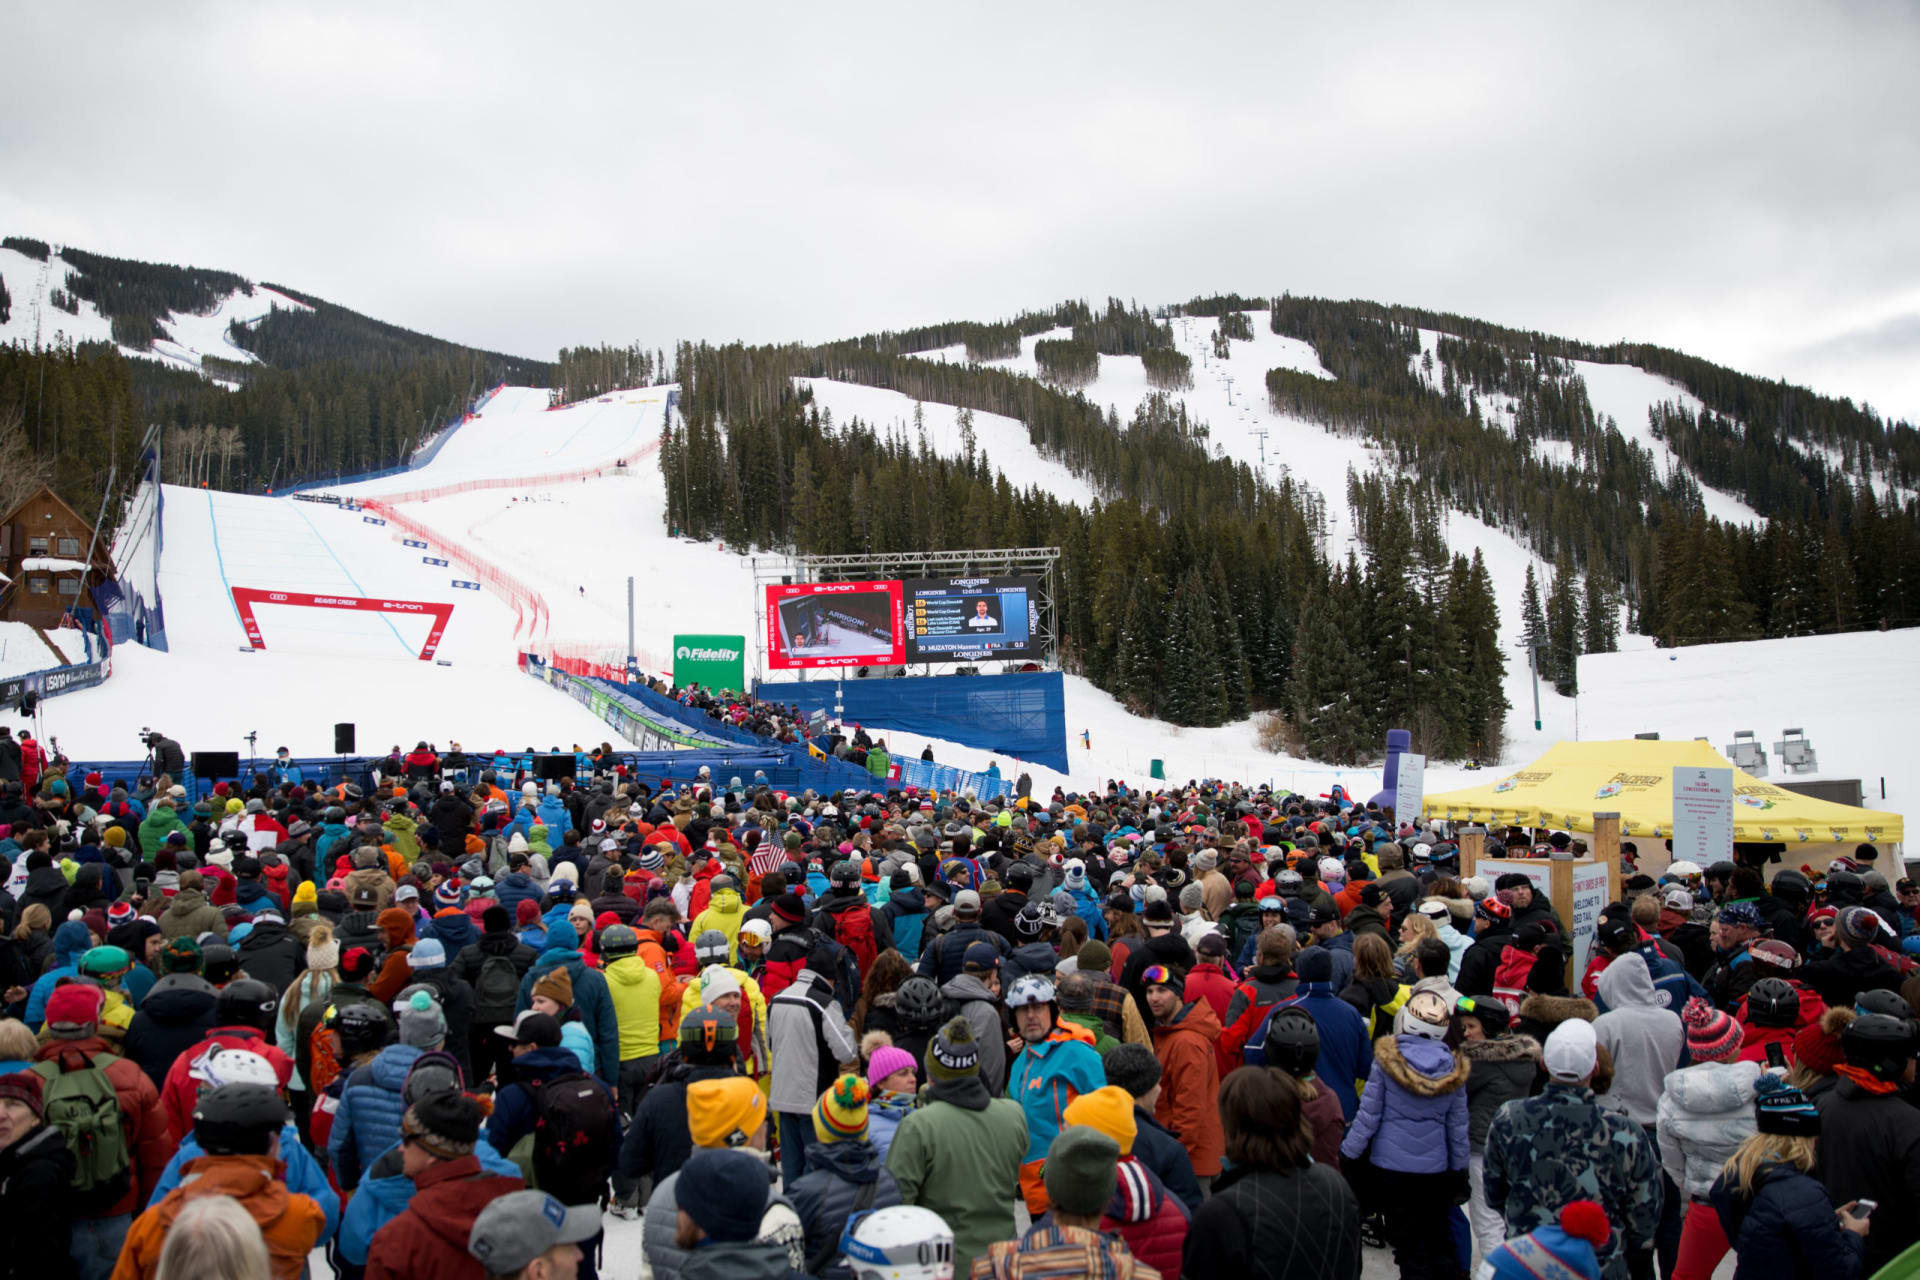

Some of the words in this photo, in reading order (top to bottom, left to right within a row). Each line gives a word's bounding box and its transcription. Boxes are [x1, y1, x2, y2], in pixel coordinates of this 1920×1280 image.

[314, 597, 337, 605] BEAVER
[383, 602, 423, 610] e-tron
[828, 610, 864, 627] ARRIGONI
[907, 605, 915, 639] LONGINES
[690, 648, 739, 661] Fidelity
[45, 672, 66, 691] USANA
[1608, 772, 1662, 785] PACIFICO
[1573, 897, 1594, 910] WELCOME
[1595, 896, 1600, 905] TO
[848, 1241, 874, 1260] SMITH
